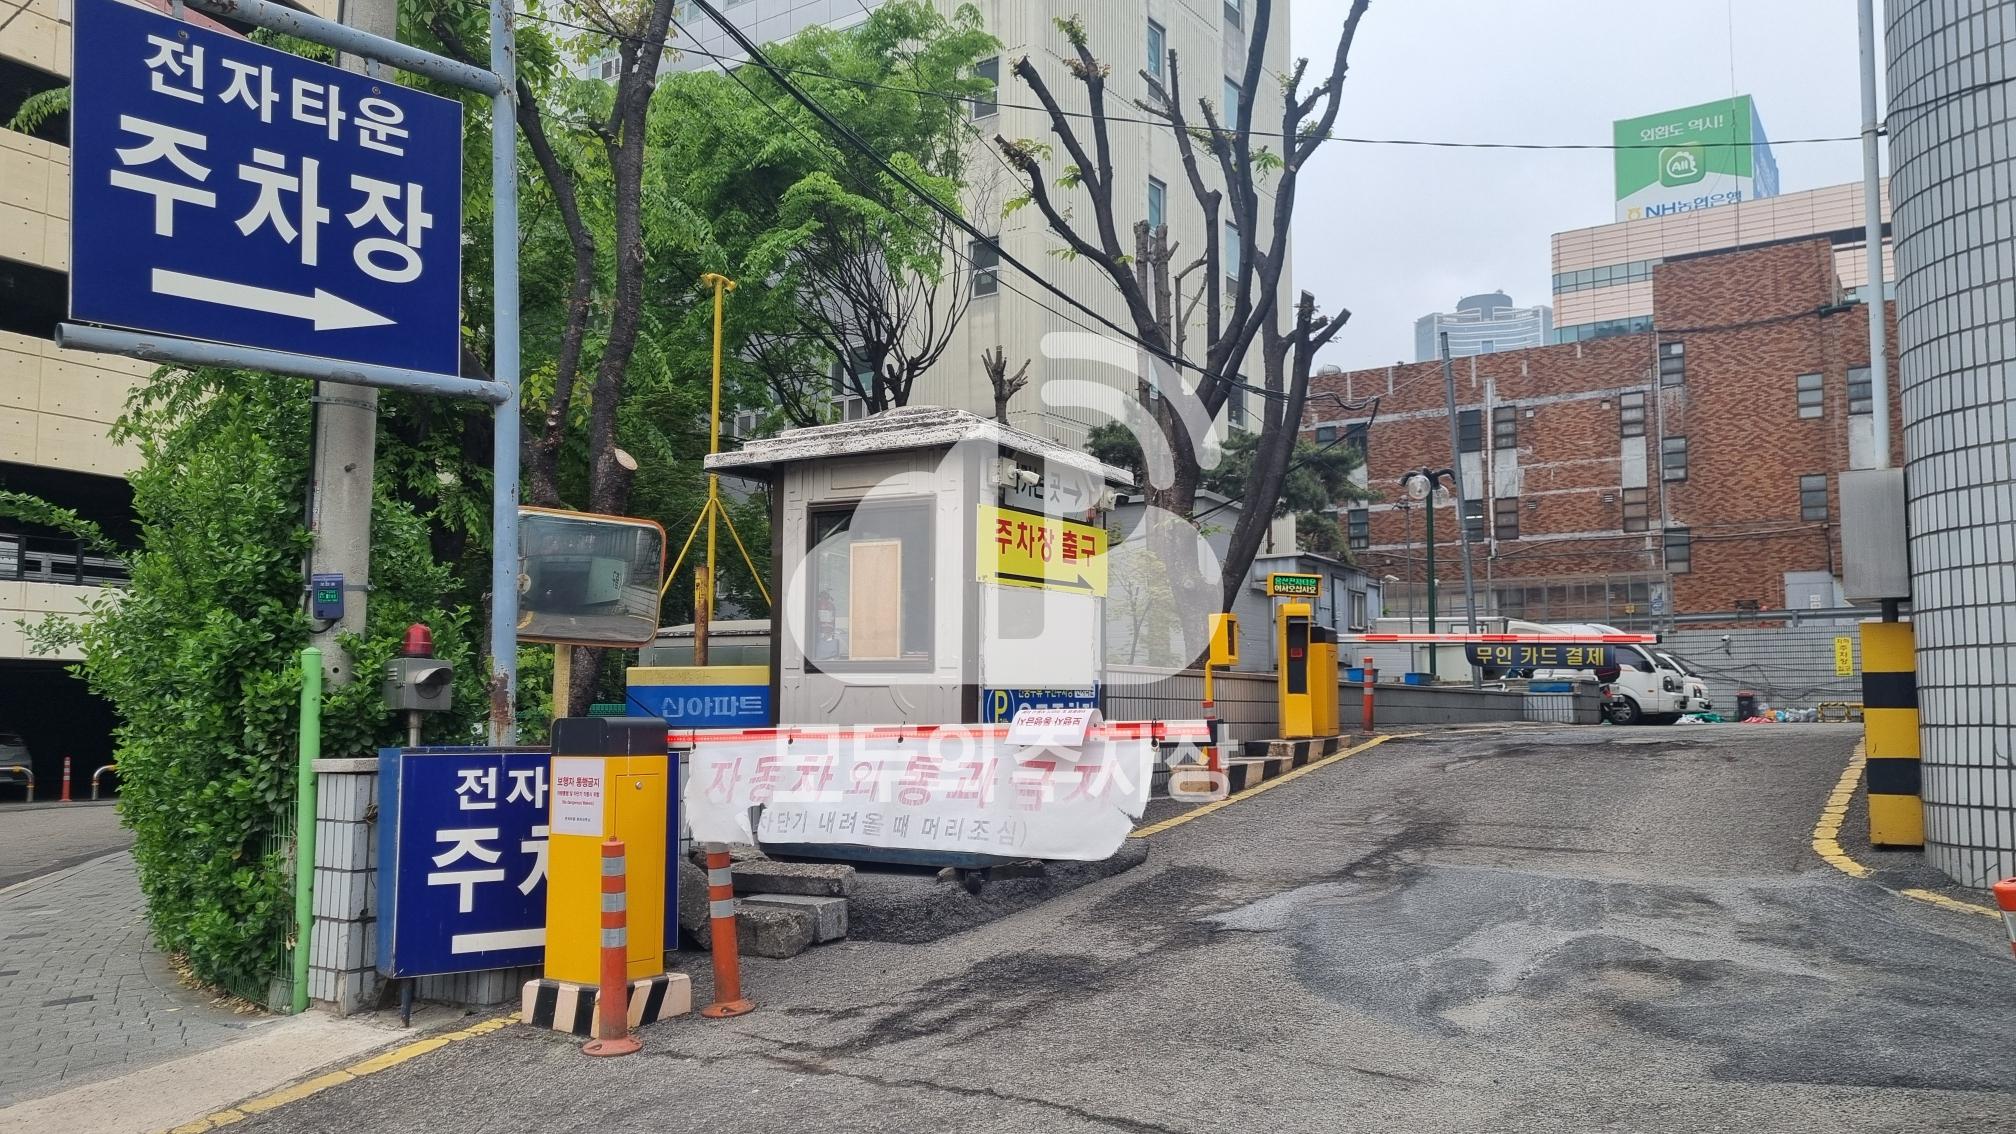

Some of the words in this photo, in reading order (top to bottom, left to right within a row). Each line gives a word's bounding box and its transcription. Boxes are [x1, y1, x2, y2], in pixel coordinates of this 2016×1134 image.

[145, 34, 409, 156] 전자타운
[1640, 122, 1685, 142] 외환도
[1688, 115, 1724, 131] 역시!
[110, 114, 433, 283] 주차장
[1645, 190, 1742, 218] NH농협은행
[995, 518, 1055, 563] 주차장
[1062, 530, 1097, 568] 출구
[1476, 646, 1512, 665] 무인
[1520, 646, 1558, 665] 카드
[1566, 646, 1604, 666] 결제
[660, 695, 764, 718] 신아파트
[704, 755, 834, 803] 자동차
[818, 810, 884, 836] 내려올
